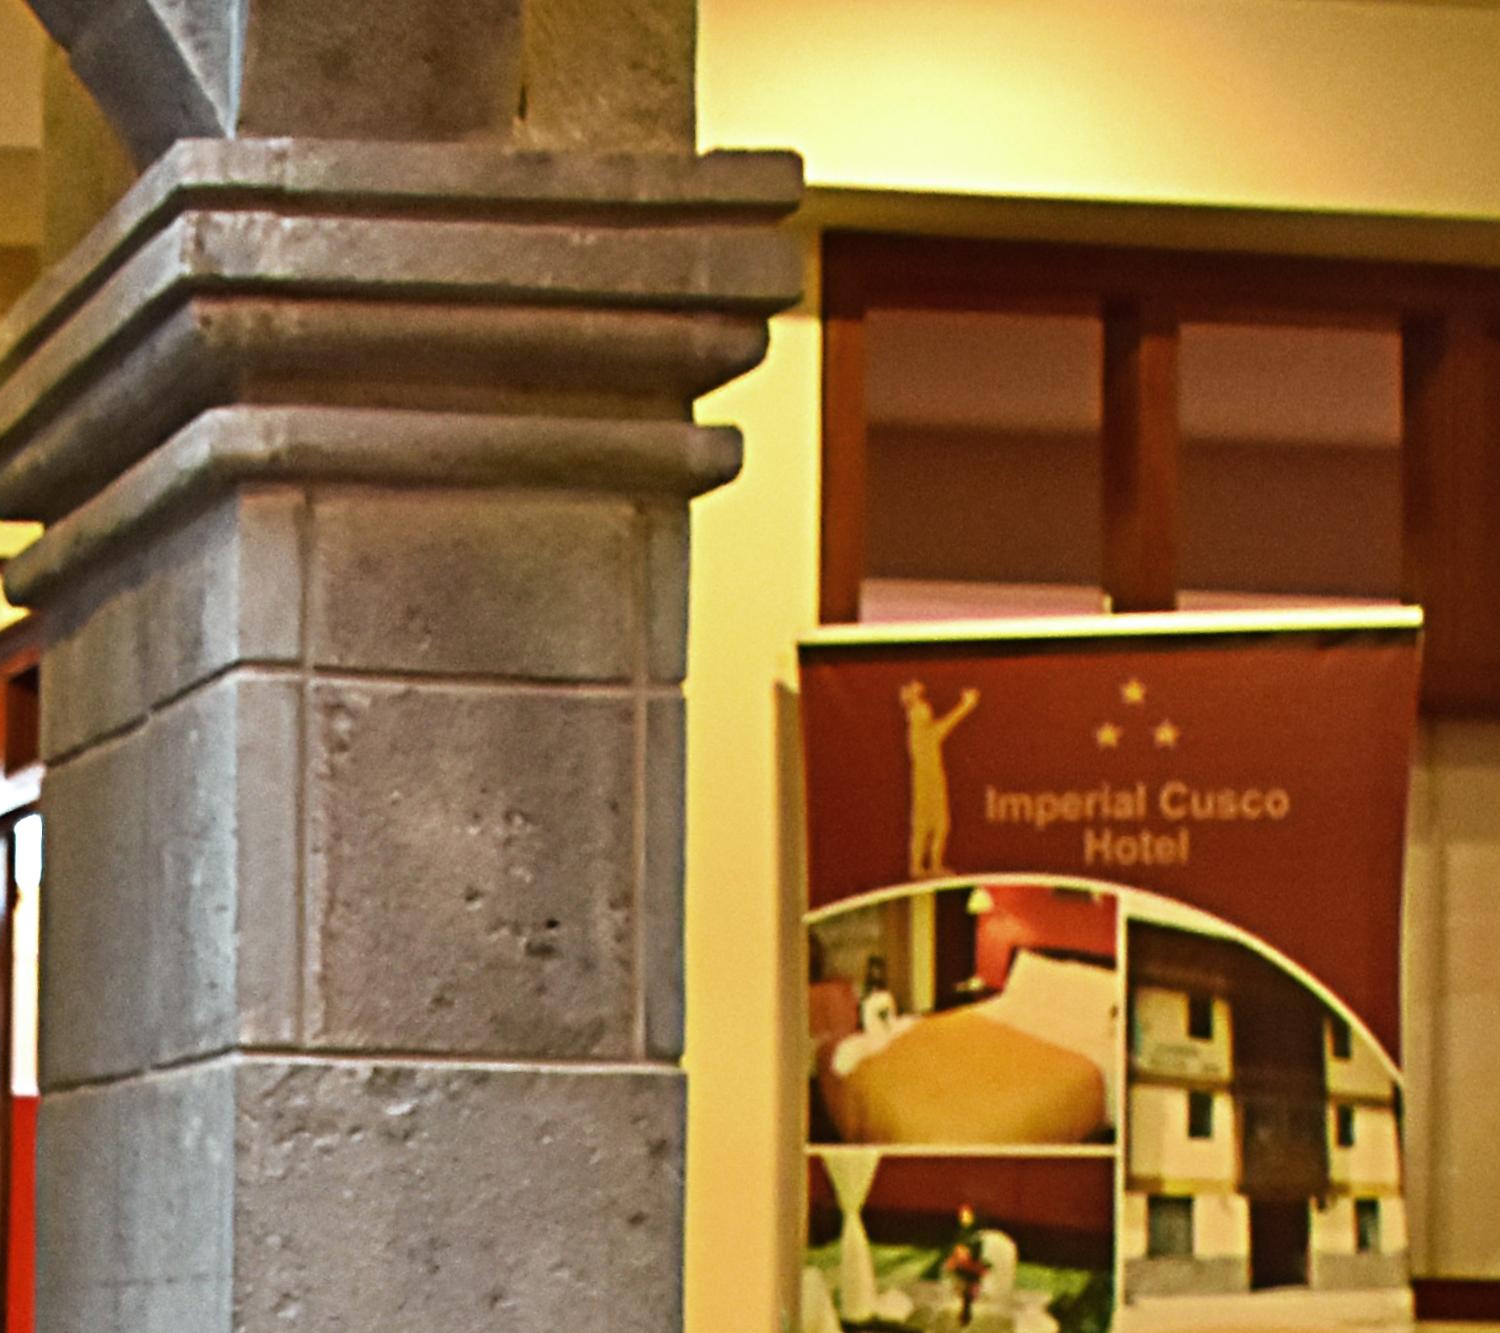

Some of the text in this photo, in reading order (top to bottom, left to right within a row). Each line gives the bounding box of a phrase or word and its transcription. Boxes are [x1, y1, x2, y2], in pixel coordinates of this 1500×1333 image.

[985, 780, 1291, 830] Imperial Cusco
[1084, 826, 1189, 865] Hotel
